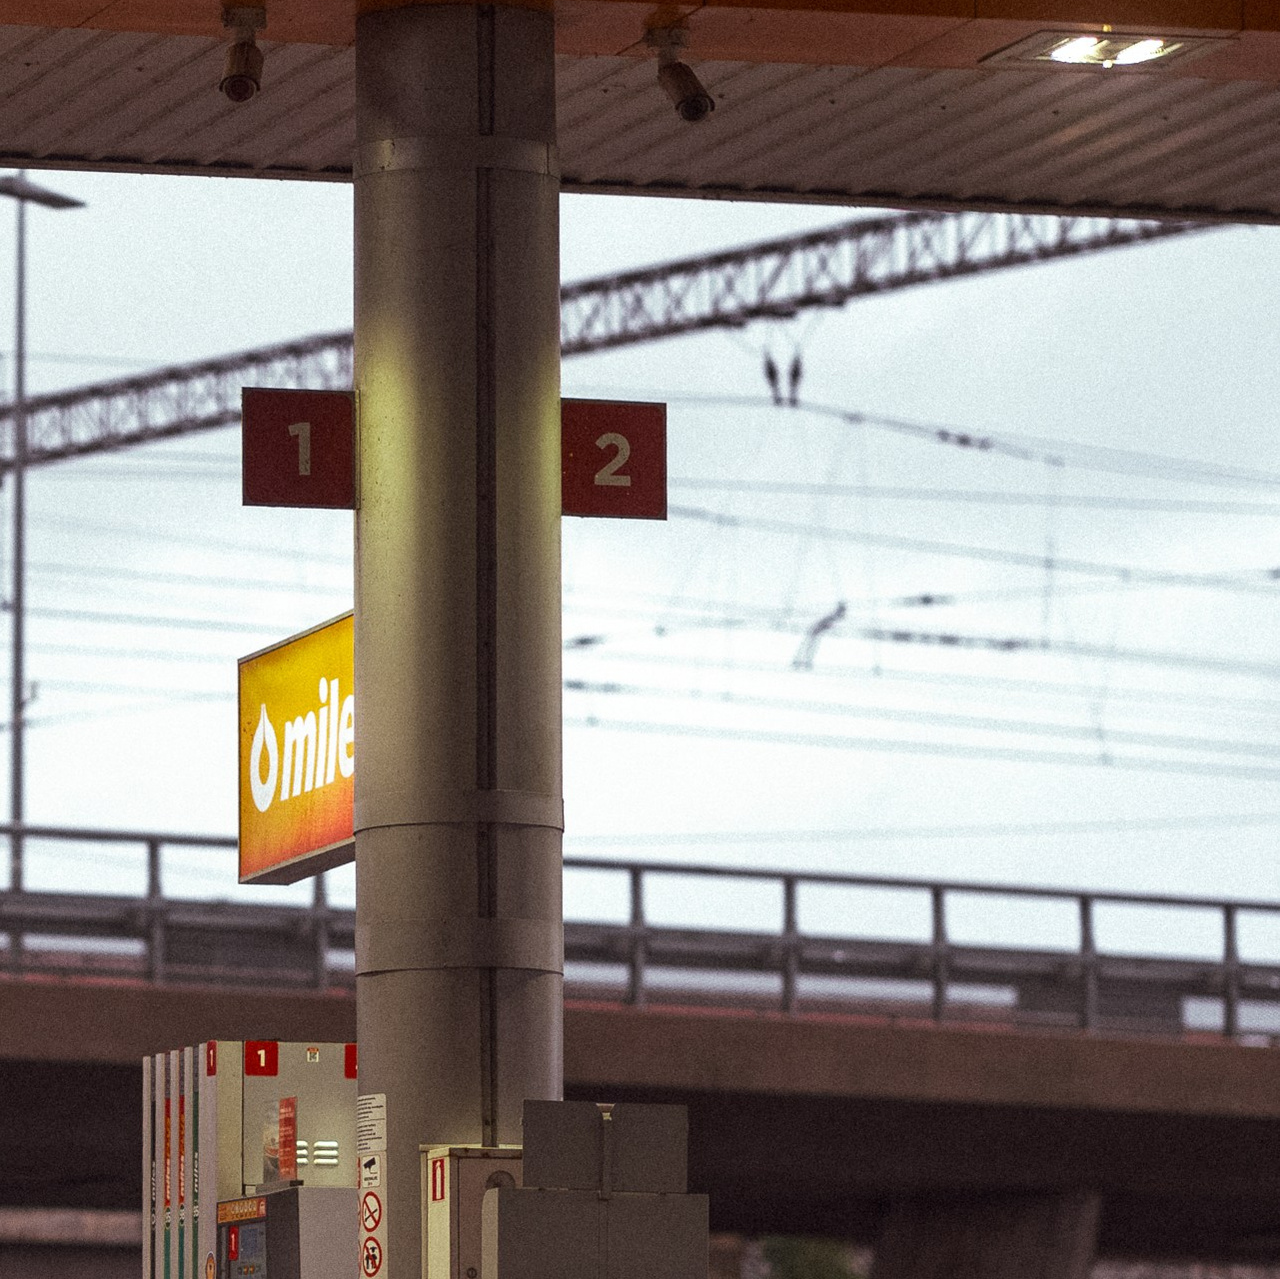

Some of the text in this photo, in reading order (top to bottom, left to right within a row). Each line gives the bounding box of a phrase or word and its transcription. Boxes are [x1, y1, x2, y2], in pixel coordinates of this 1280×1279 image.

[287, 421, 311, 476] 1
[593, 431, 632, 487] 2
[257, 1049, 266, 1067] 1
